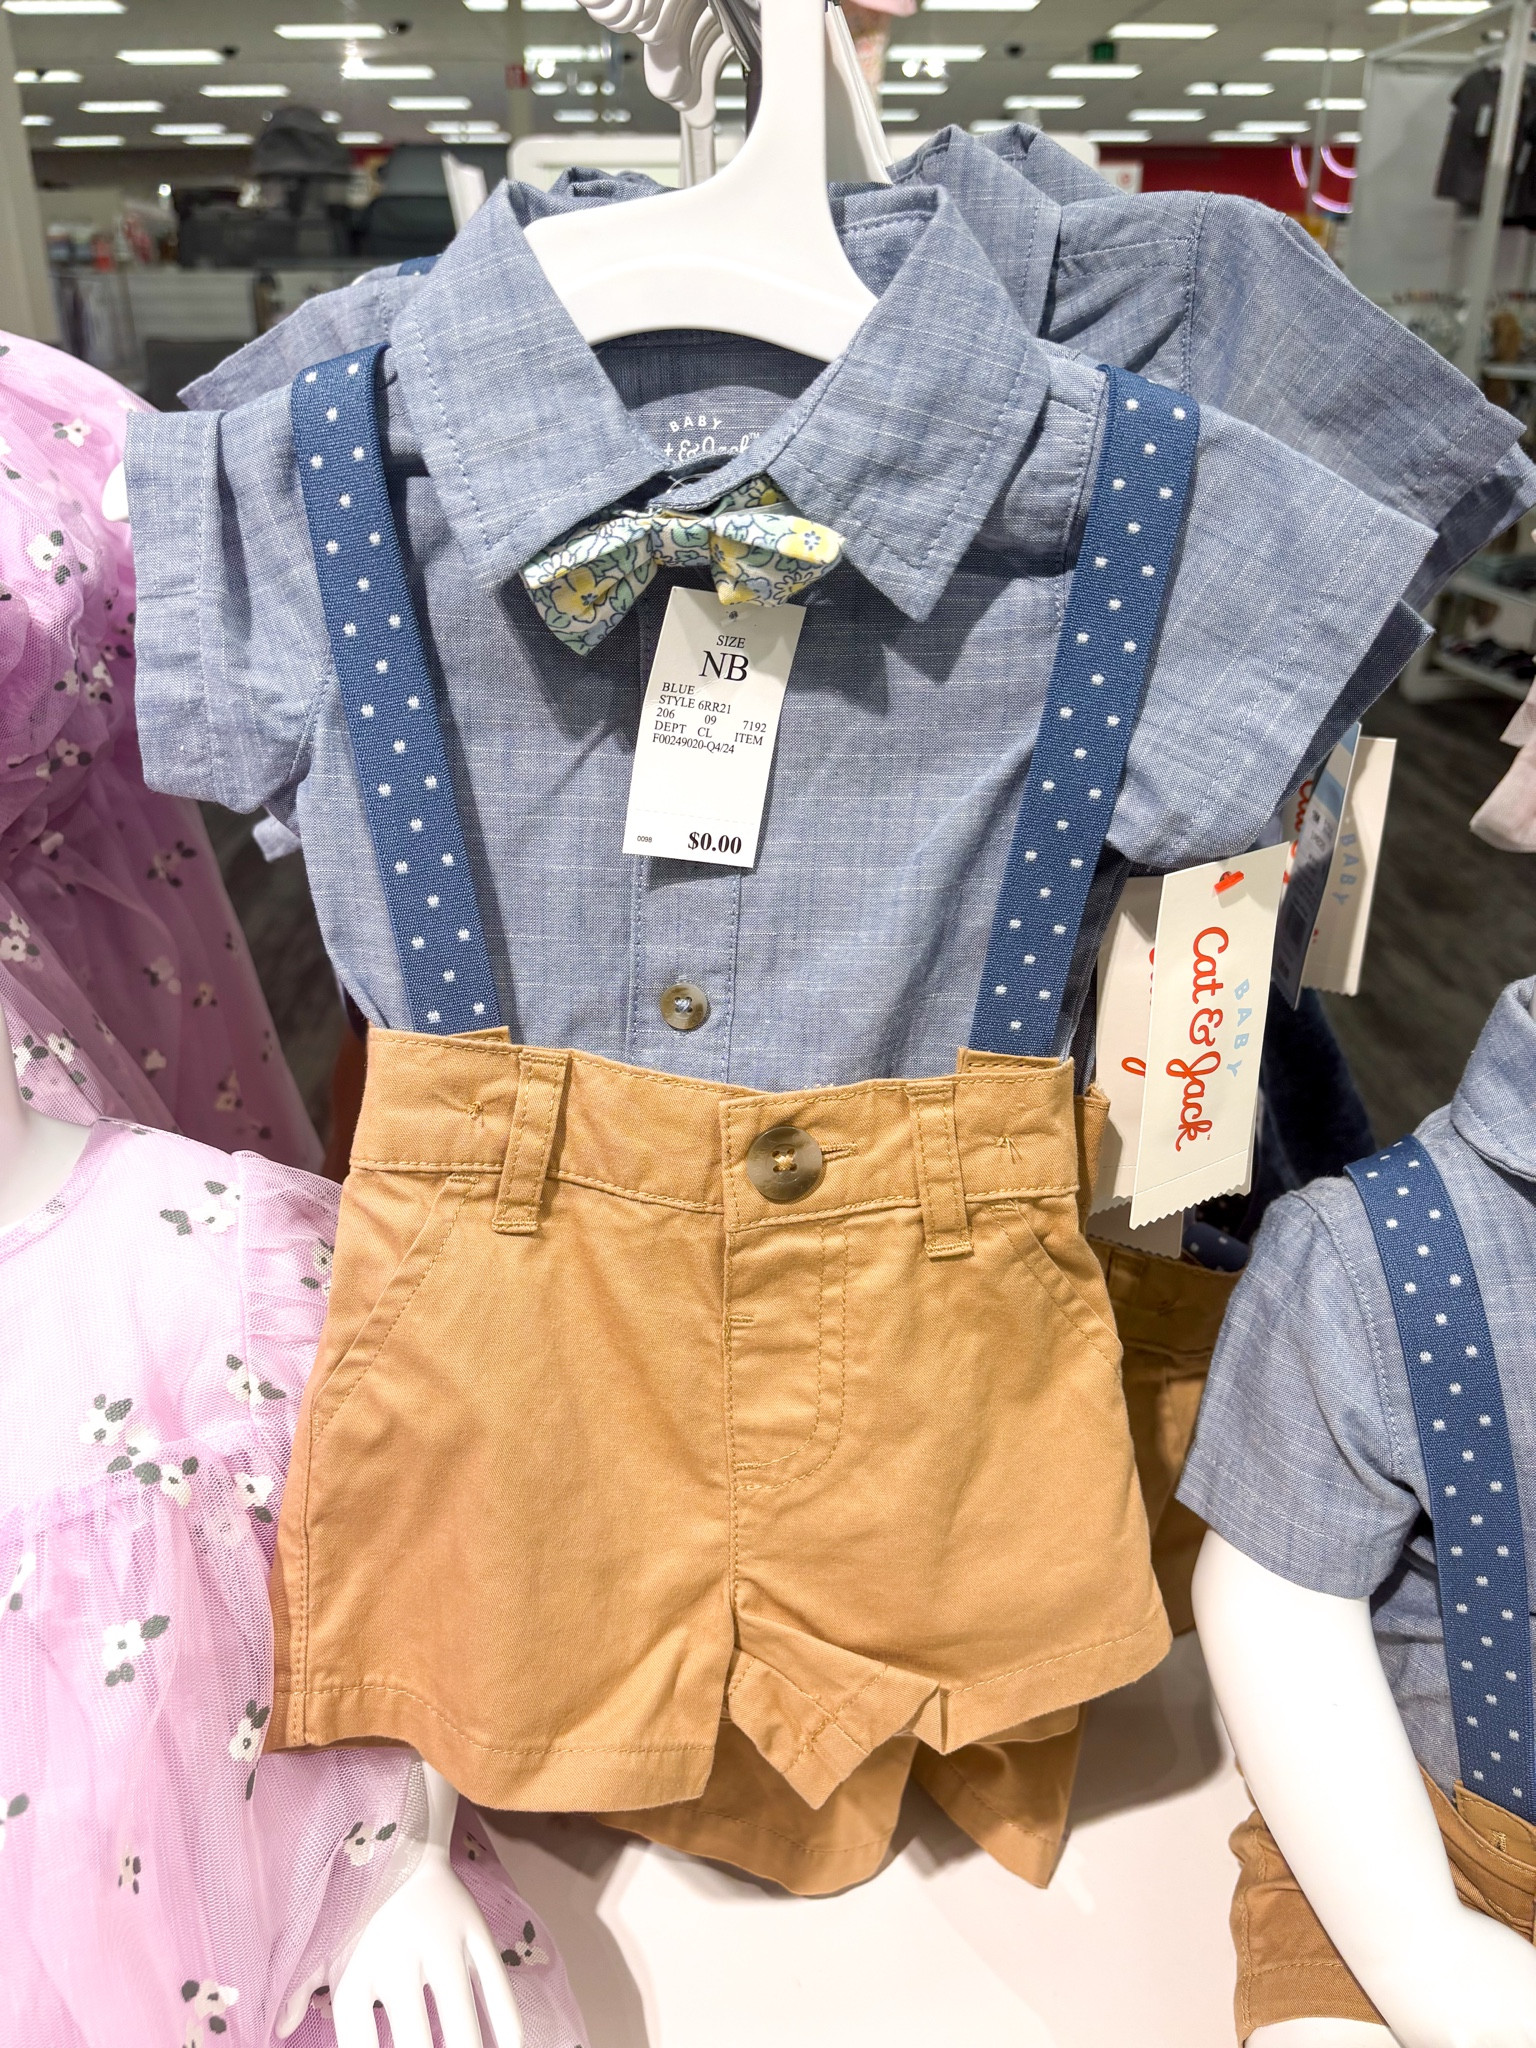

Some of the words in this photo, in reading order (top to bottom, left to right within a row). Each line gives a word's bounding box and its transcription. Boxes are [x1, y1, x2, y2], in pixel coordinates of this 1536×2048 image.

[669, 415, 722, 432] BABY
[716, 635, 746, 648] SIZE
[699, 651, 749, 682] NB
[662, 682, 695, 695] BLUE
[658, 694, 695, 708] STYLE
[698, 700, 731, 714] 6RR21
[656, 707, 675, 719] 206
[704, 714, 717, 725] 09
[743, 720, 767, 732] 7192
[652, 733, 735, 754] F00249020-Q4/24
[654, 720, 687, 734] DEPT
[697, 727, 713, 738] CL
[734, 732, 763, 746] ITEM
[687, 831, 742, 854] $0.00
[1332, 833, 1359, 905] BABY
[1192, 926, 1229, 1005] Cat
[1189, 1007, 1224, 1047] &
[1226, 978, 1252, 1078] BABY
